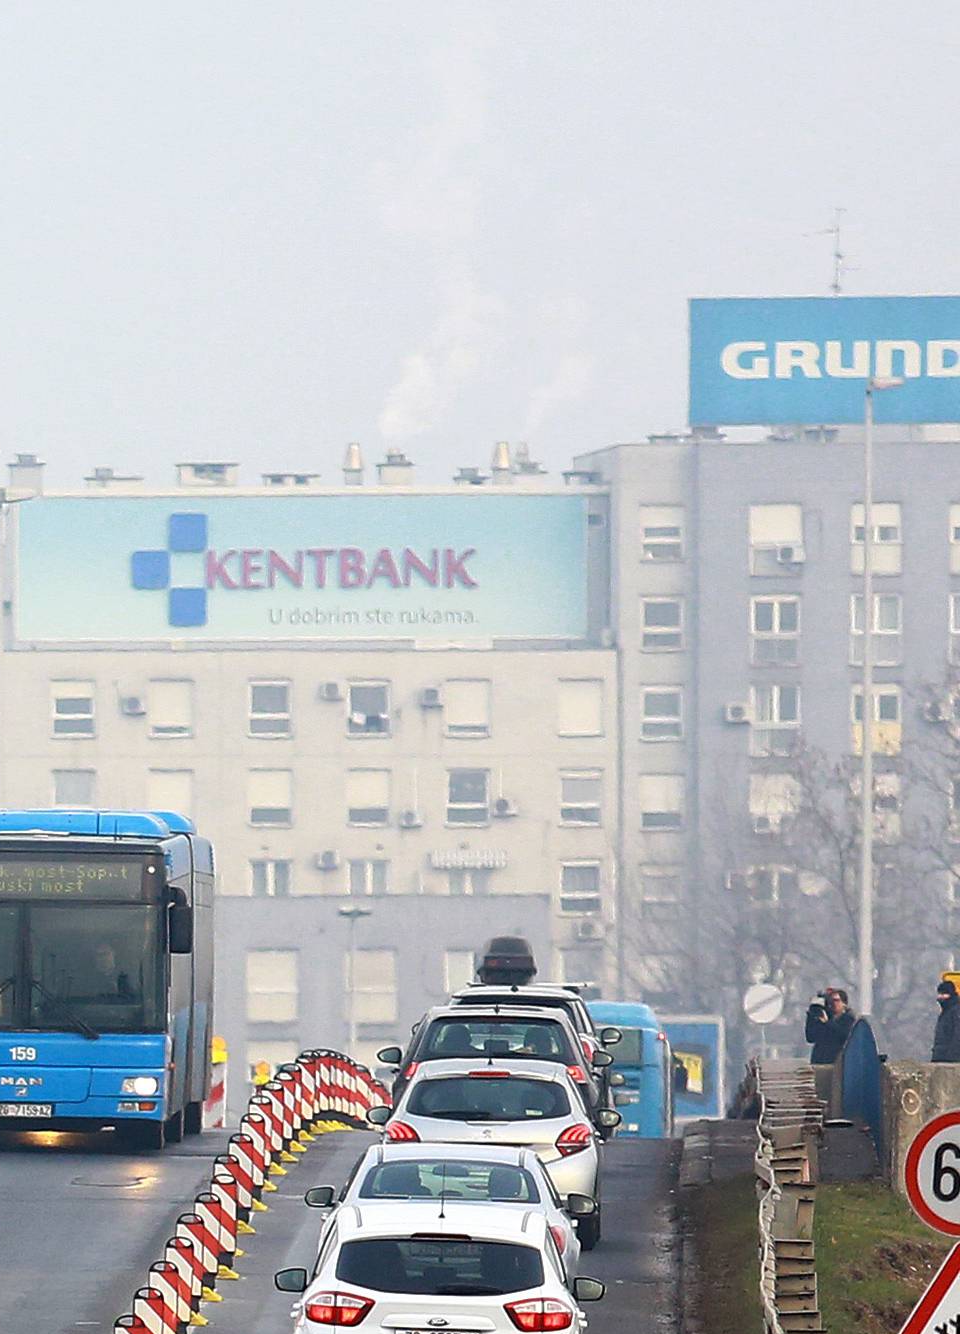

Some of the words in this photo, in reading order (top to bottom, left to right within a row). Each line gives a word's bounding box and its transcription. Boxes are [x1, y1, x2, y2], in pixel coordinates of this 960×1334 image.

[721, 340, 960, 379] GRUND
[205, 547, 478, 589] KENTBANK
[269, 608, 283, 624] U
[290, 607, 359, 625] dobrim
[366, 609, 392, 625] ste
[10, 1047, 36, 1061] 159
[0, 1077, 43, 1086] MAN
[933, 1143, 960, 1202] 6
